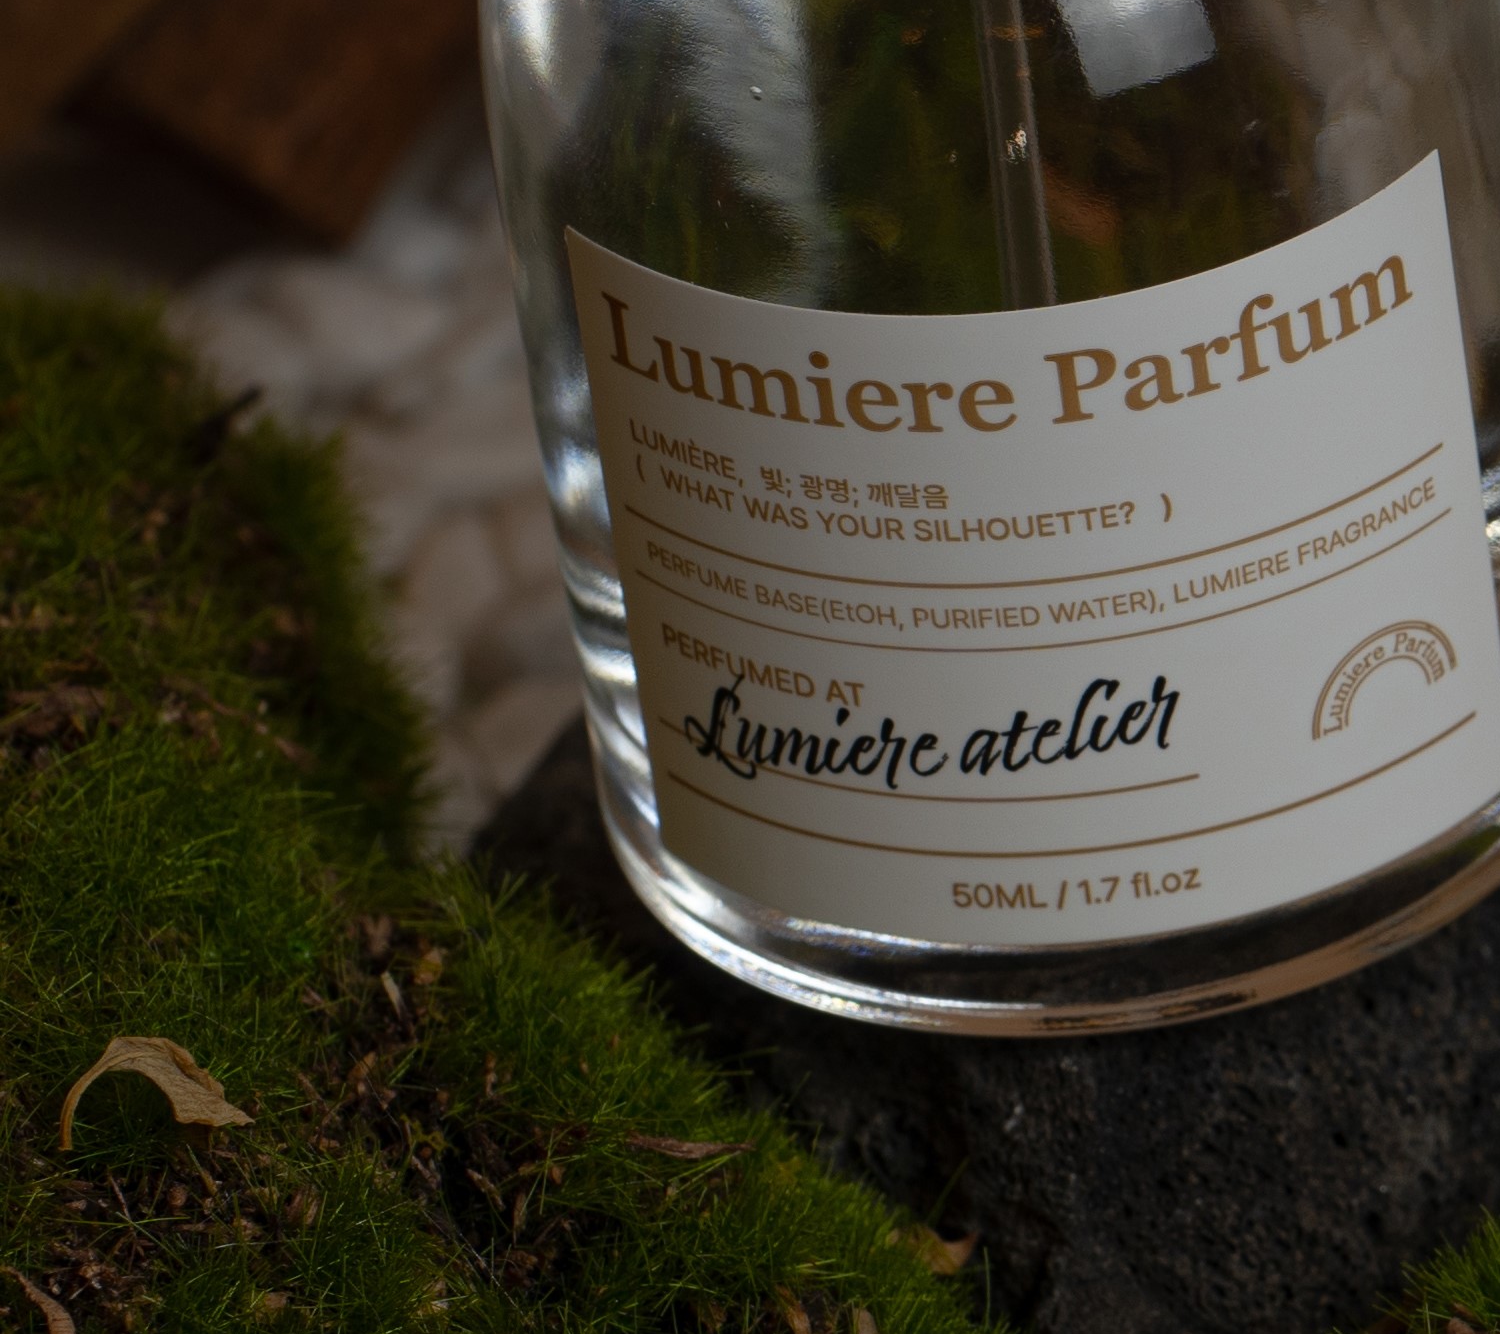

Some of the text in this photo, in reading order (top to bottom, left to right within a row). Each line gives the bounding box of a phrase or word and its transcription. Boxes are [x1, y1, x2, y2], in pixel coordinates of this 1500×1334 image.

[601, 253, 1414, 433] Lumiere Parfum
[629, 418, 745, 487] LUMIÈRE,
[799, 474, 860, 508] 광명;
[867, 481, 950, 510] 깨달음
[659, 464, 735, 513] WHAT
[744, 497, 809, 530] WAS
[816, 509, 904, 541] YOUR
[915, 500, 1136, 543] SILHOUETTE?
[647, 539, 747, 601] PERFUME
[912, 605, 1041, 630] PURIFIED
[1048, 588, 1166, 627] WATER),
[1173, 550, 1291, 604] LUMIERE
[1297, 476, 1436, 566] FRAGRANCE
[661, 621, 865, 709] PERFUMED AT
[1323, 631, 1446, 736] Lumiere Parfum
[684, 673, 1181, 790] Lumiere atelier
[952, 880, 1048, 911] 50ML
[1076, 875, 1121, 906] 1.7
[1130, 866, 1202, 898] fl.oz
